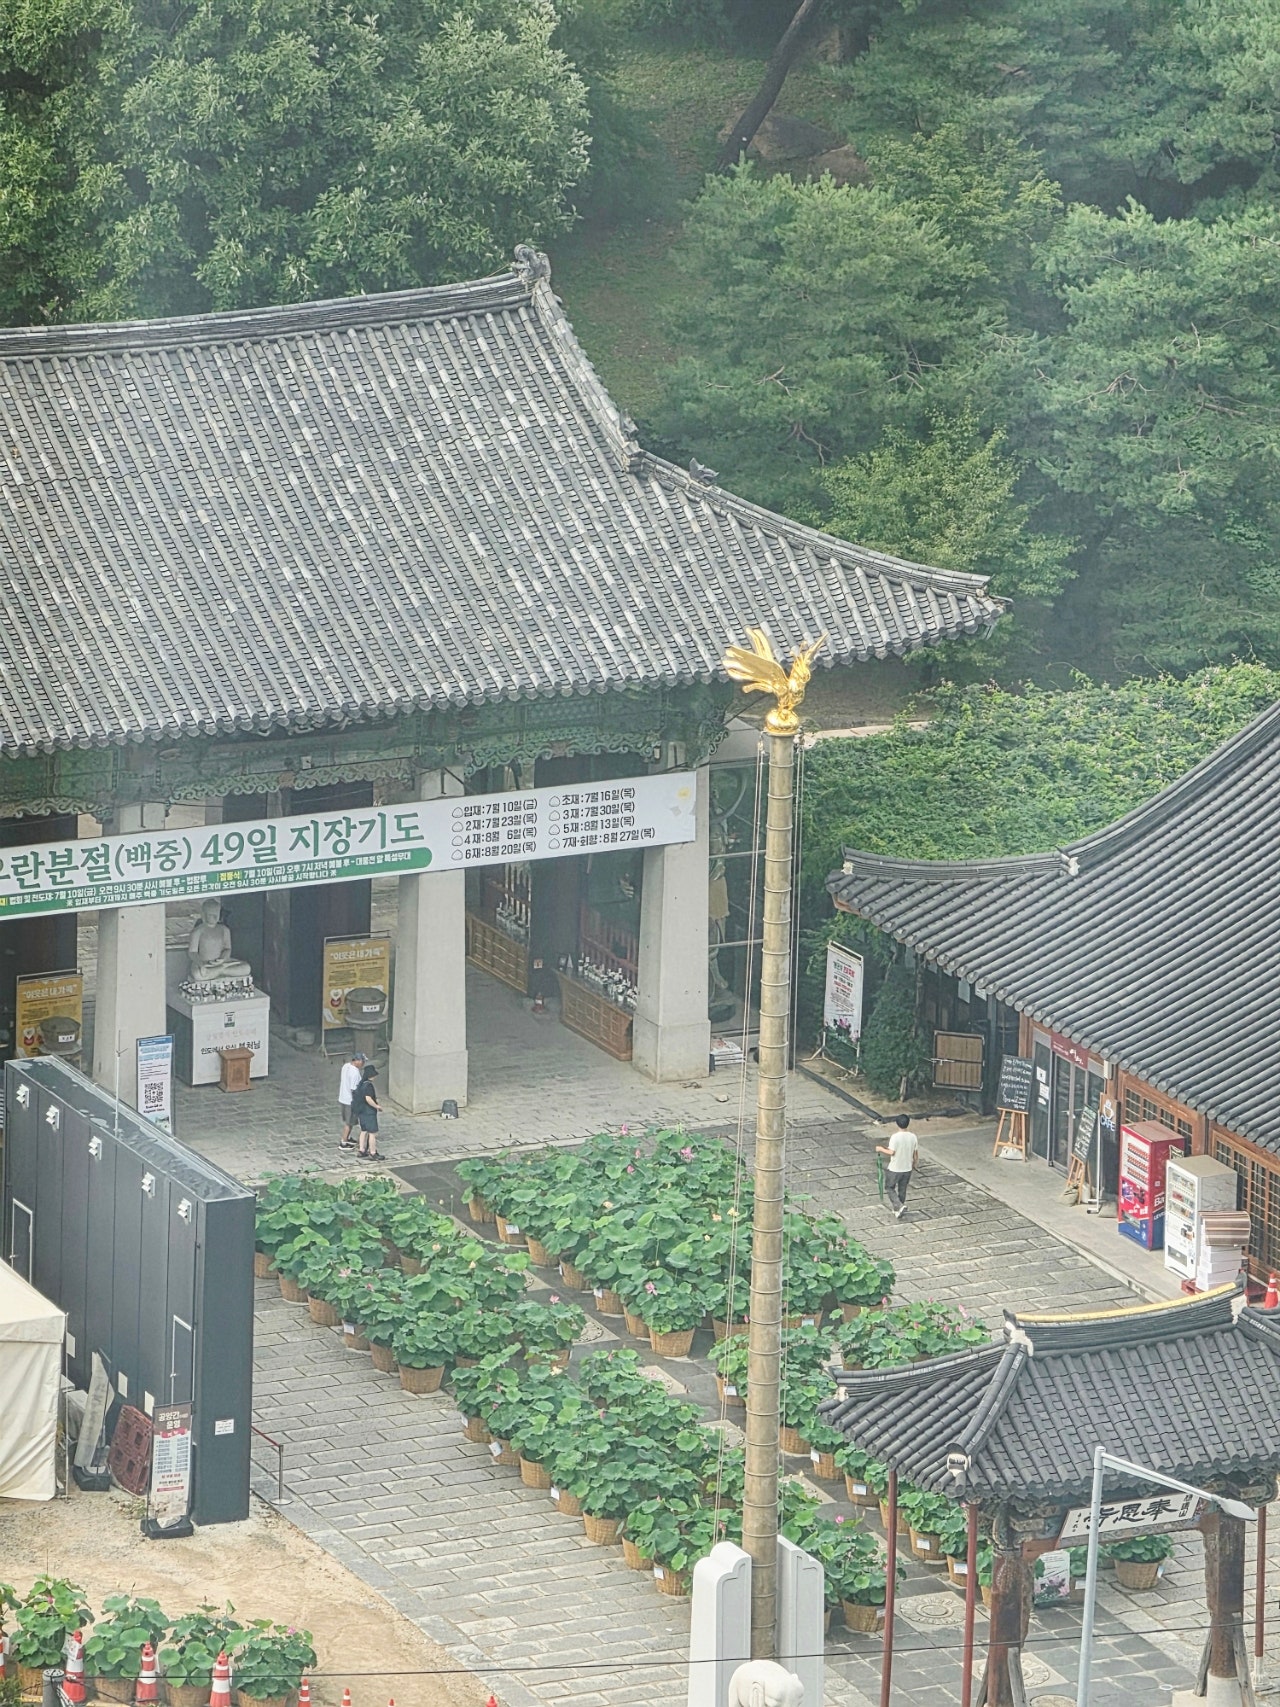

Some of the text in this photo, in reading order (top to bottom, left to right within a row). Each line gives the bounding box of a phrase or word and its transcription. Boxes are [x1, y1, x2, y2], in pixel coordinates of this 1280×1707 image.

[600, 788, 635, 802] 16일(목)
[502, 799, 537, 813] 10일(금)
[600, 802, 635, 816] 30일(목)
[501, 813, 537, 827] 23일(목)
[600, 816, 635, 830] 13일(목)
[201, 825, 278, 867] 49일
[289, 811, 425, 858] 지장기도
[507, 827, 537, 840] 6일(목)
[501, 841, 537, 855] 20일(목)
[257, 867, 285, 878] 10일(금)
[302, 863, 313, 872] 7시
[54, 890, 66, 900] 7월
[67, 888, 96, 899] 10일(금)
[99, 886, 113, 896] 오전
[114, 885, 126, 894] 9시
[1101, 1114, 1116, 1132] CAFE
